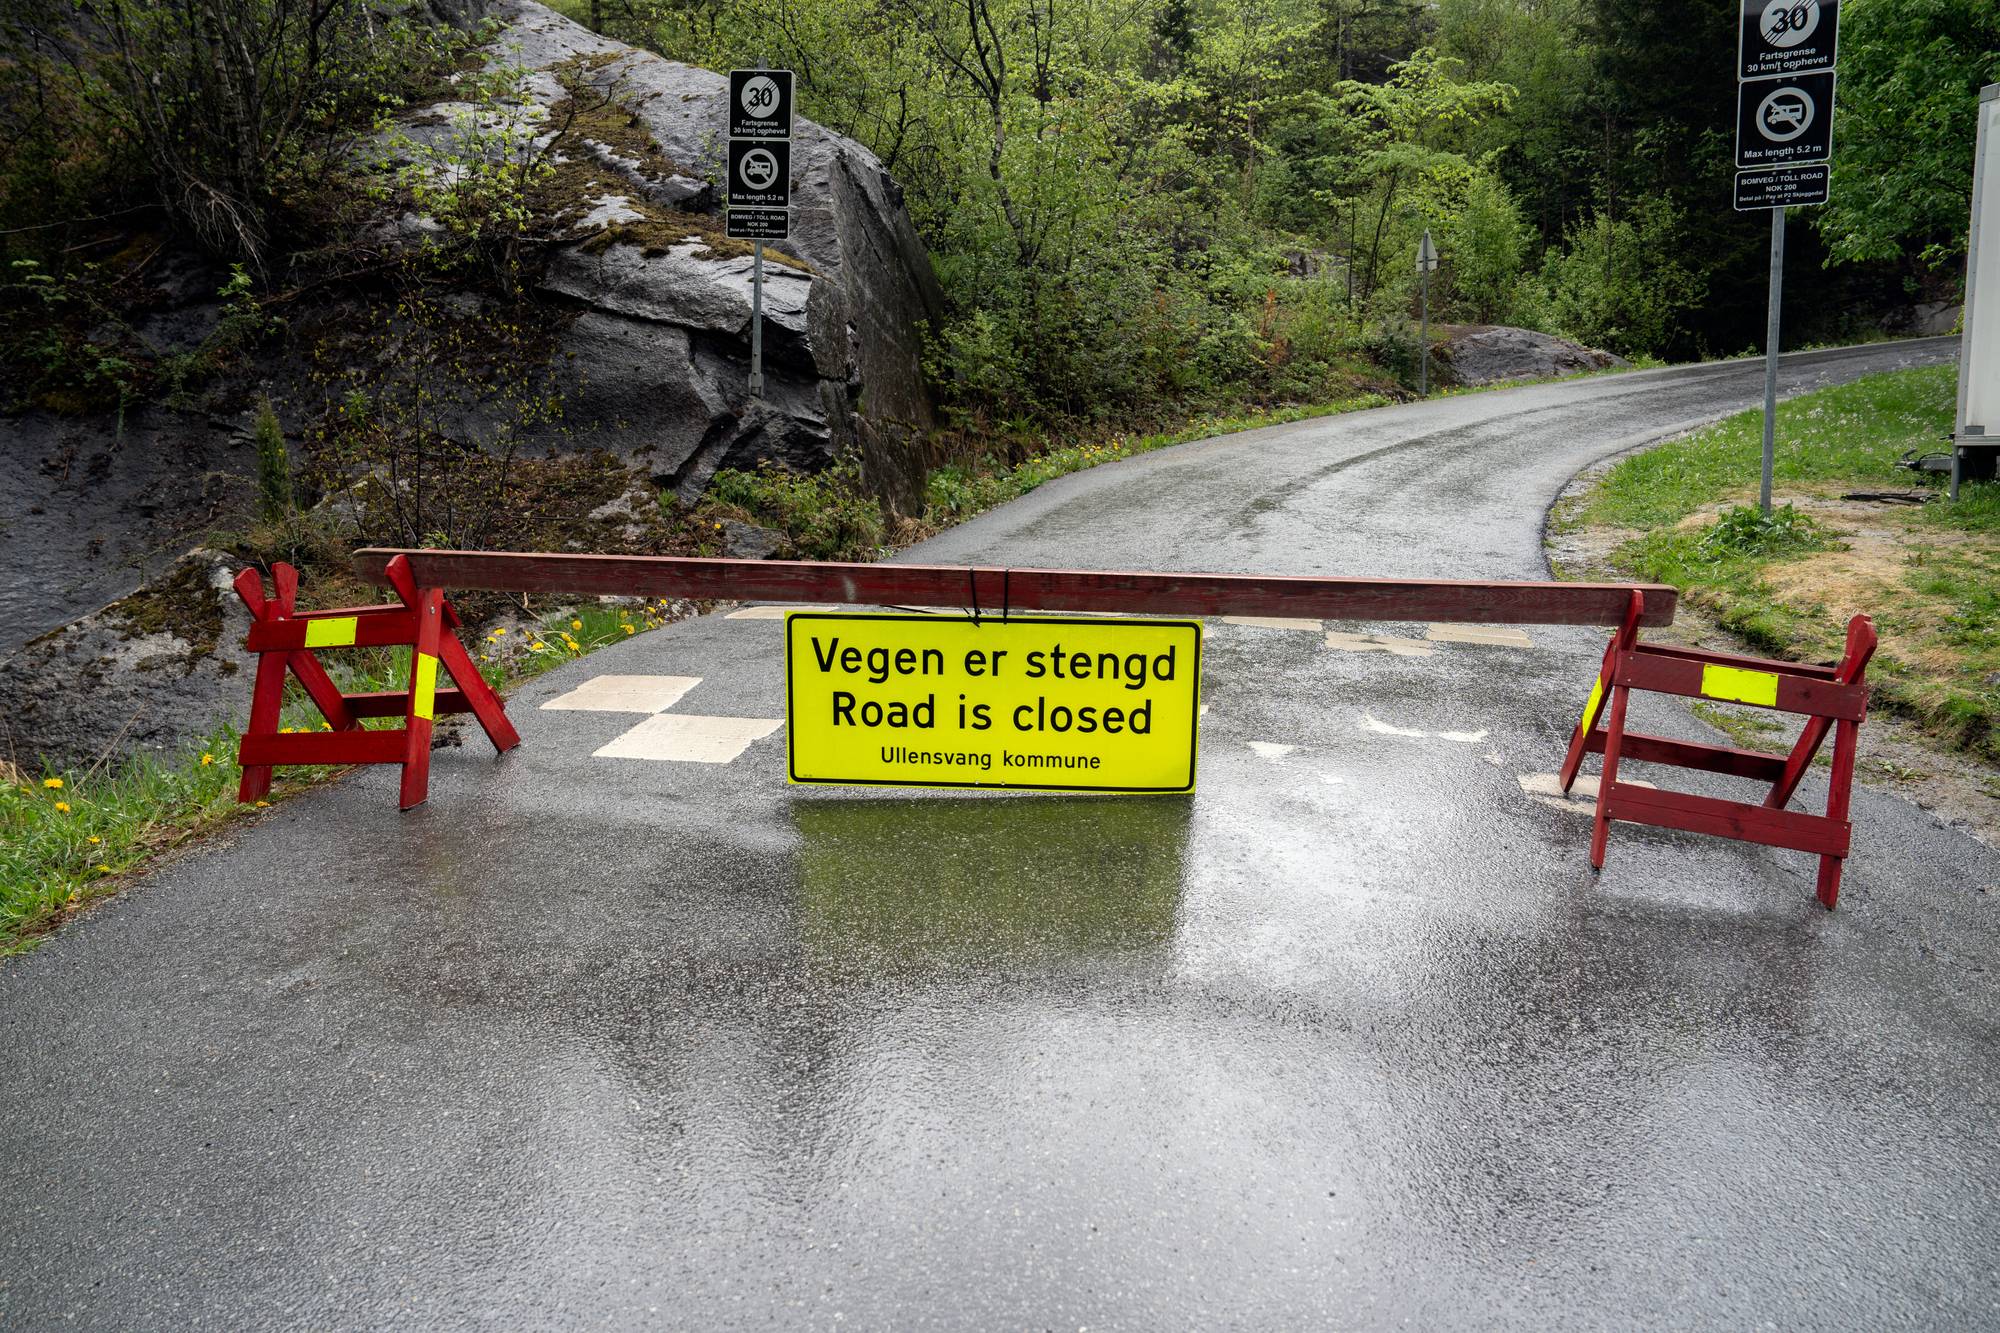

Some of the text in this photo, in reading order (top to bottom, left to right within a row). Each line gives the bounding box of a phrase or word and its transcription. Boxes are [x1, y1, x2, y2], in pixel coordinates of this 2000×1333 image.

[1772, 5, 1808, 33] 30
[1747, 55, 1827, 72] 30 km/t opphevet
[1760, 47, 1816, 60] Fartsgrense
[749, 87, 772, 107] 30
[1744, 150, 1762, 158] Max
[1765, 147, 1794, 157] length
[1796, 145, 1810, 154] 5.2
[1741, 176, 1774, 185] BOMVEG
[1801, 172, 1823, 180] ROAD
[811, 637, 1176, 689] Vegen er stengd
[832, 691, 1152, 735] Road is closed
[881, 746, 1101, 770] Ullensvang kommune
